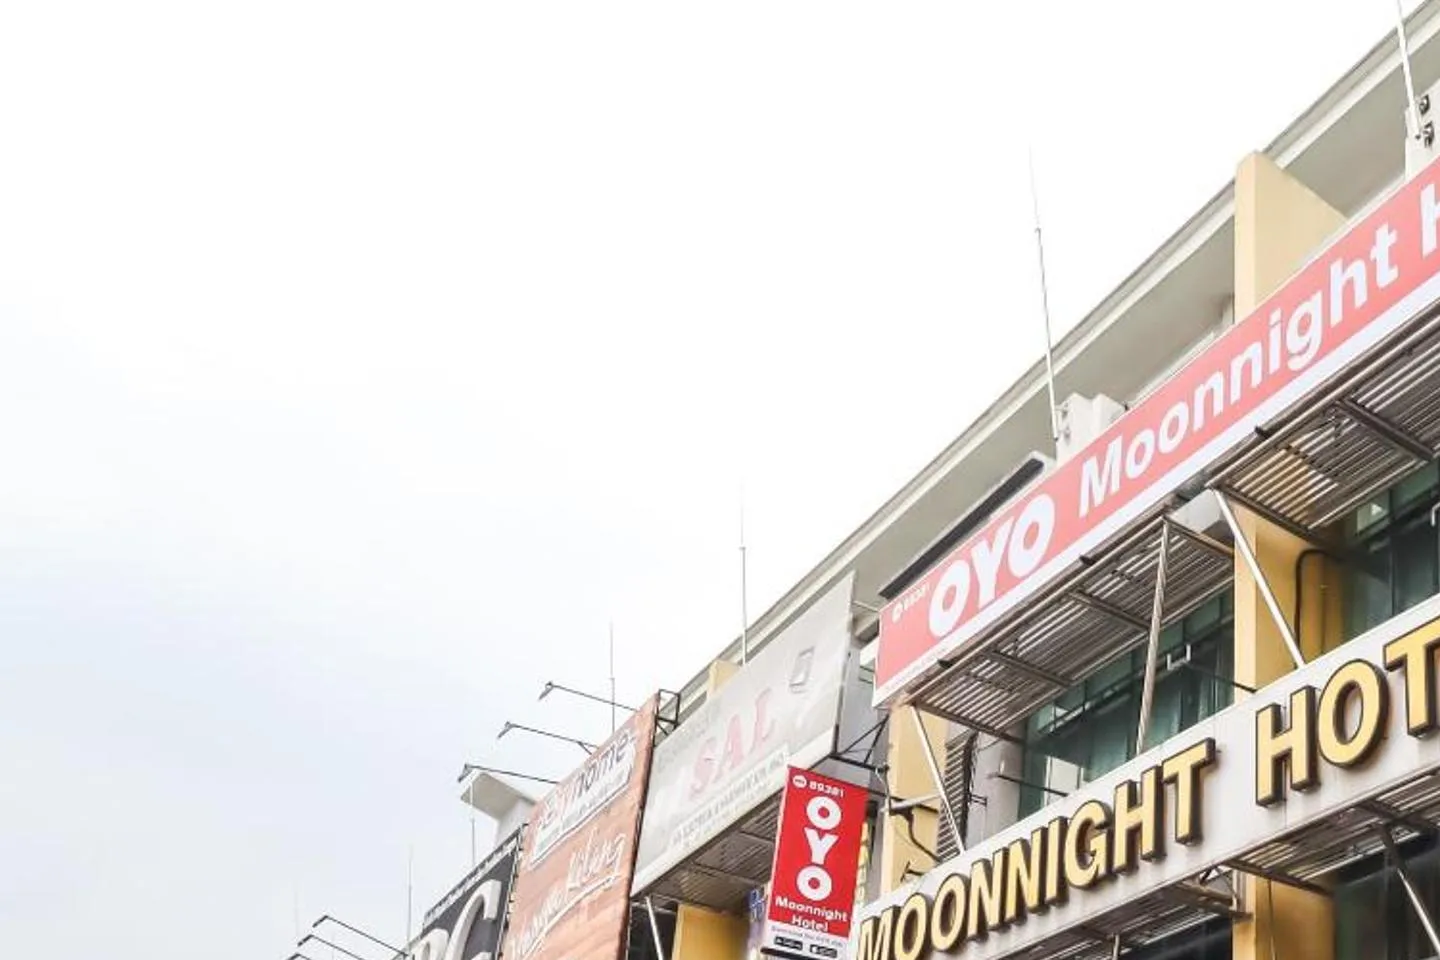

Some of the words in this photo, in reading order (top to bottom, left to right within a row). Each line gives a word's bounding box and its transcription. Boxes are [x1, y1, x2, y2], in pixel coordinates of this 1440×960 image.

[929, 494, 1056, 638] OYO
[1078, 219, 1398, 517] Moonnight
[796, 795, 842, 901] OYO
[775, 894, 849, 922] Moonnight
[791, 914, 828, 932] Hotel
